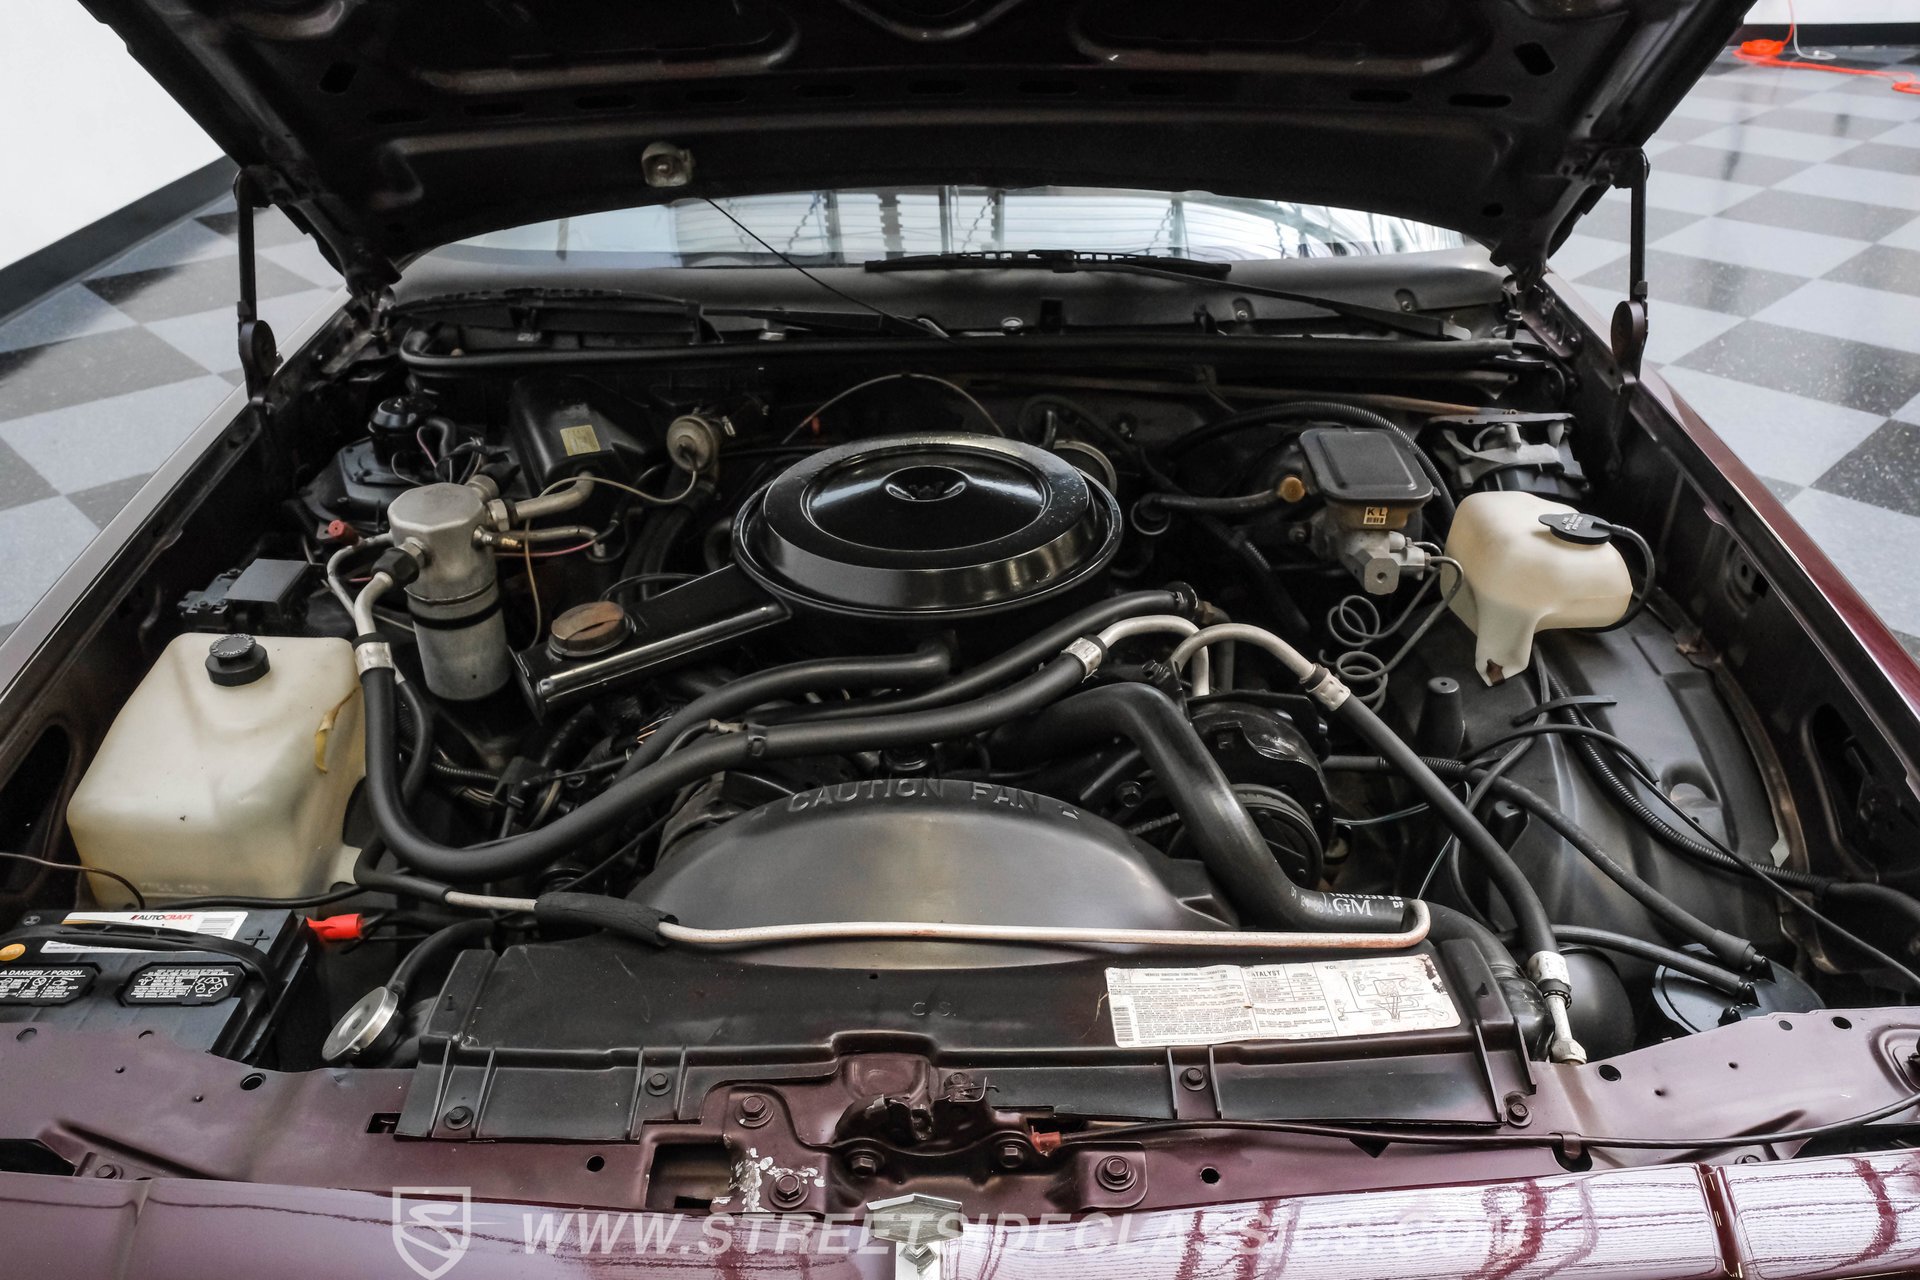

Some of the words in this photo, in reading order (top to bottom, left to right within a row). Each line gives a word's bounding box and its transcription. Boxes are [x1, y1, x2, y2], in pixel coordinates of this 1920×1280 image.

[788, 778, 944, 812] CAUTION
[970, 781, 1041, 815] FAN
[1332, 897, 1373, 917] GM
